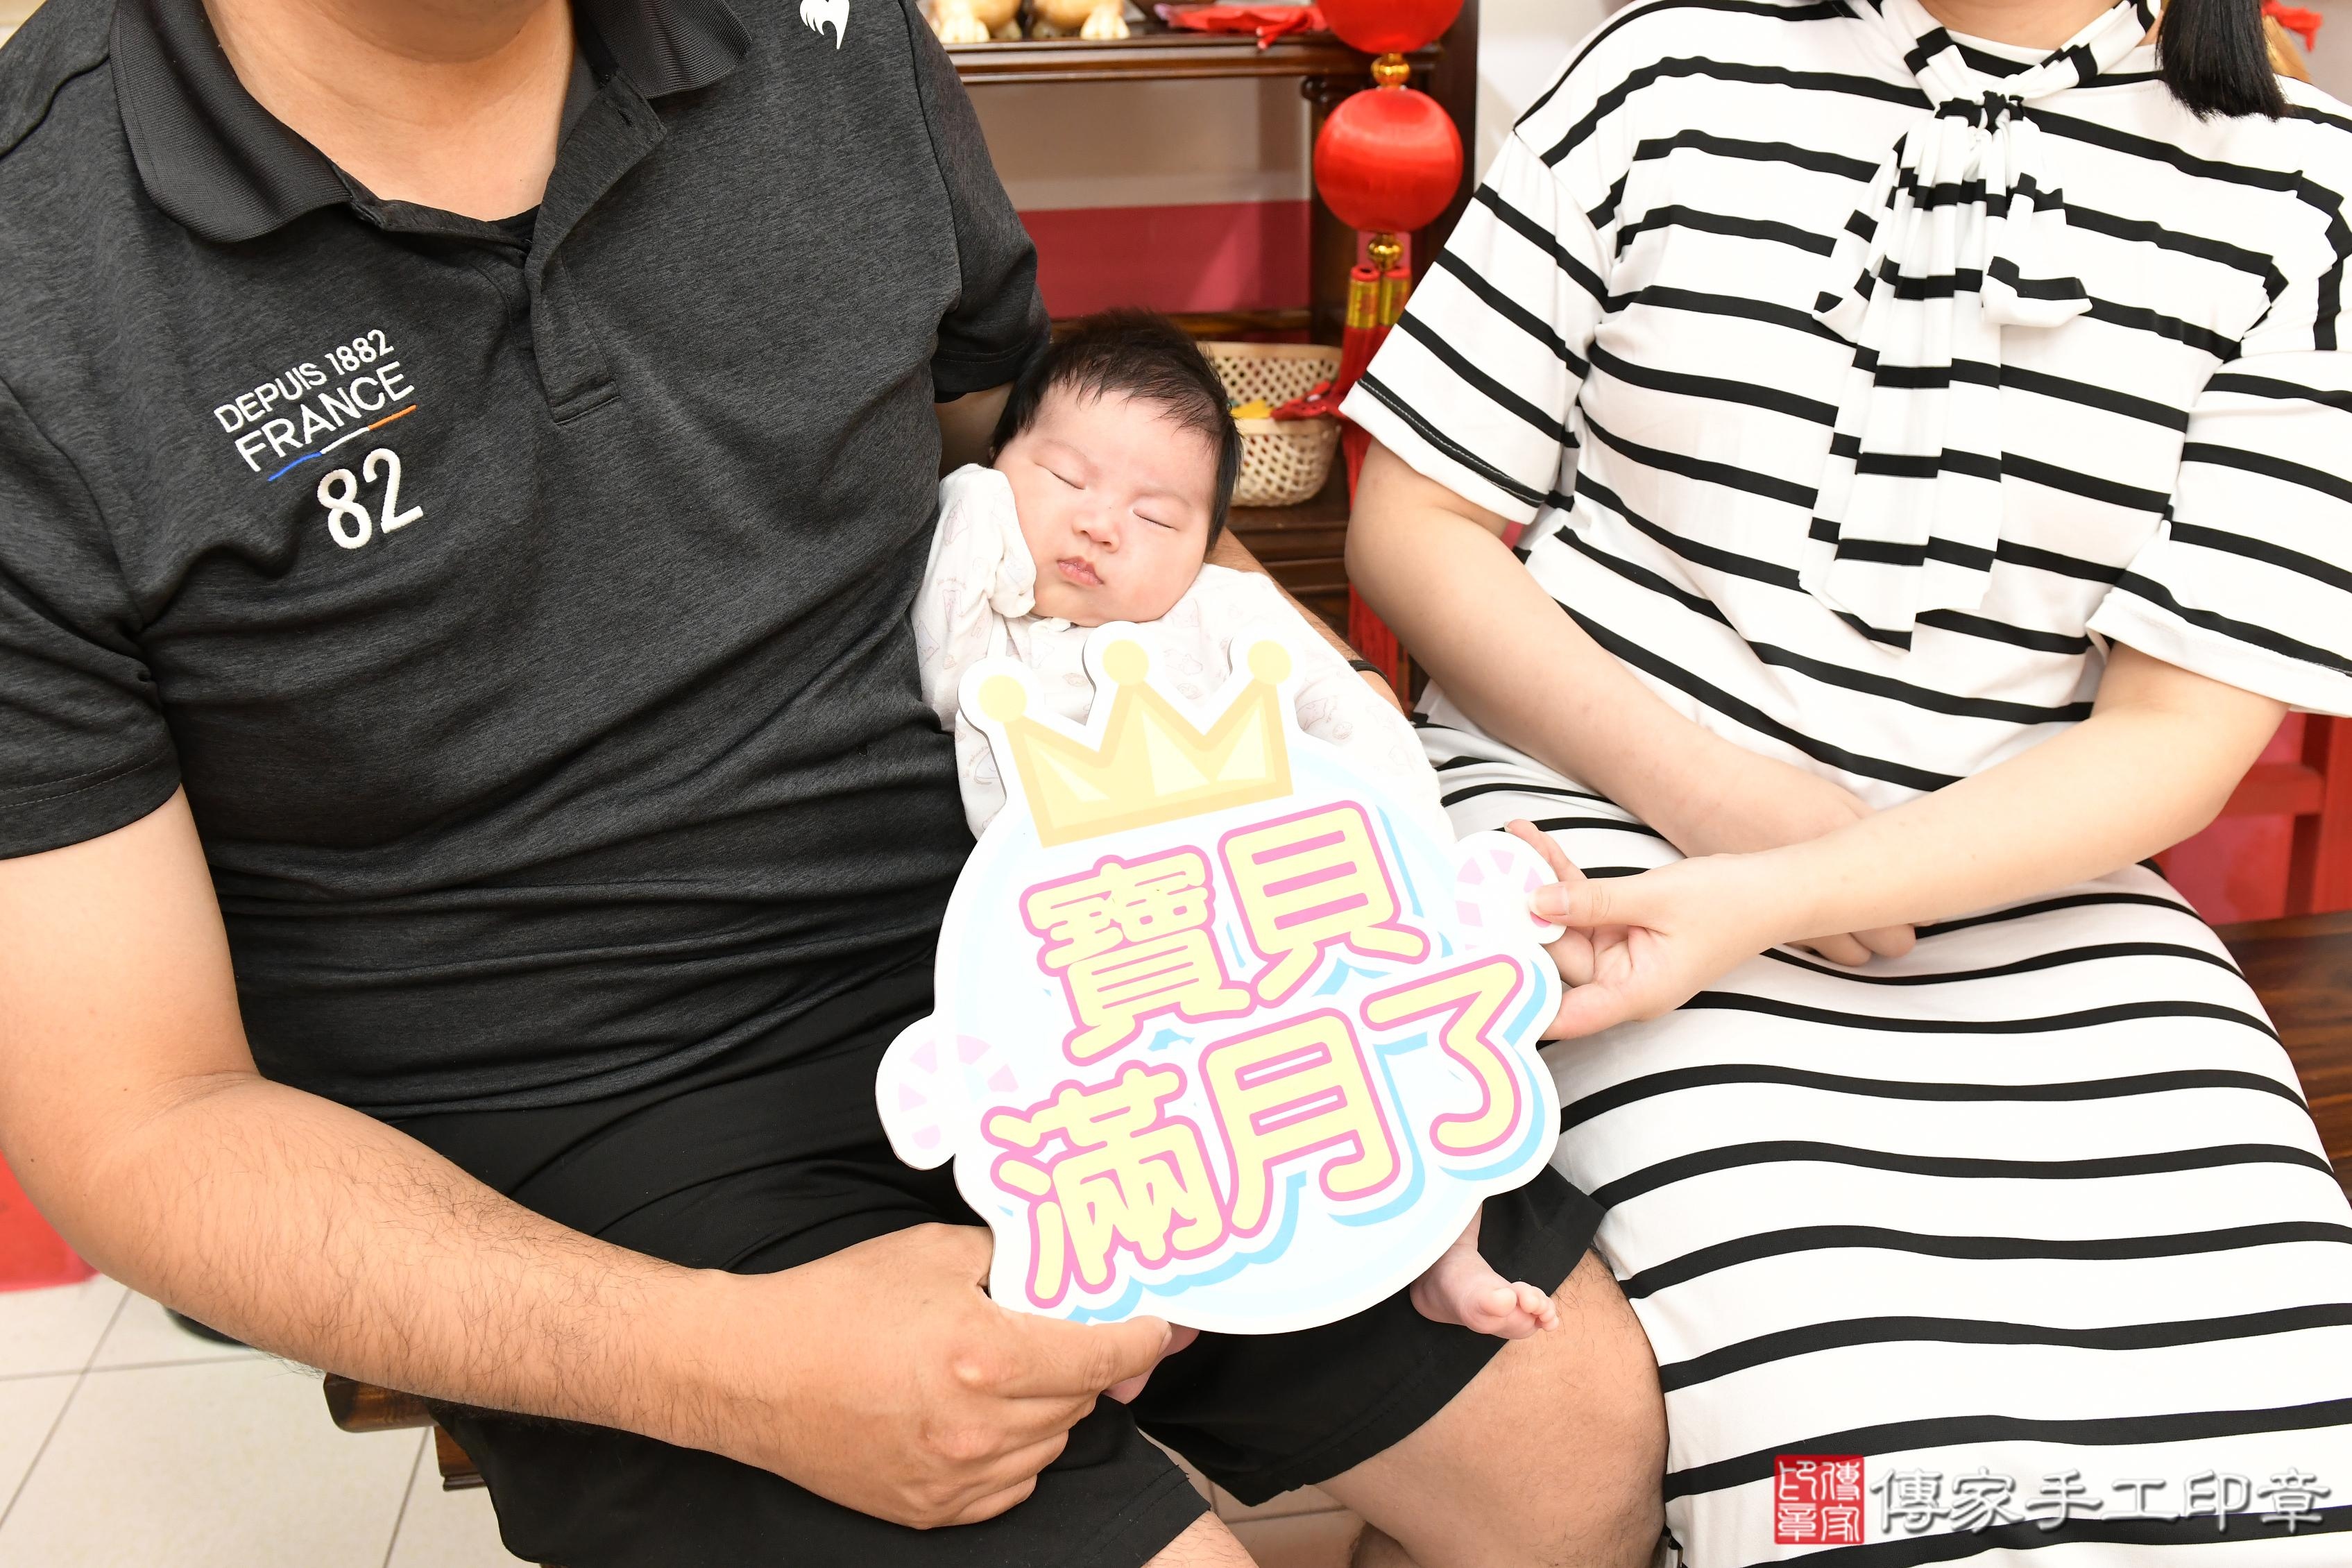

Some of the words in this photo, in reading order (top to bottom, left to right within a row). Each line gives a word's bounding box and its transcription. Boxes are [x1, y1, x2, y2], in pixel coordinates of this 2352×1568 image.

[214, 363, 327, 433] DEPUIS
[325, 330, 394, 375] 1882
[235, 361, 415, 472] FRANCE
[317, 448, 424, 549] 82
[1020, 801, 1430, 1066] 寶貝
[981, 954, 1524, 1309] 滿月了
